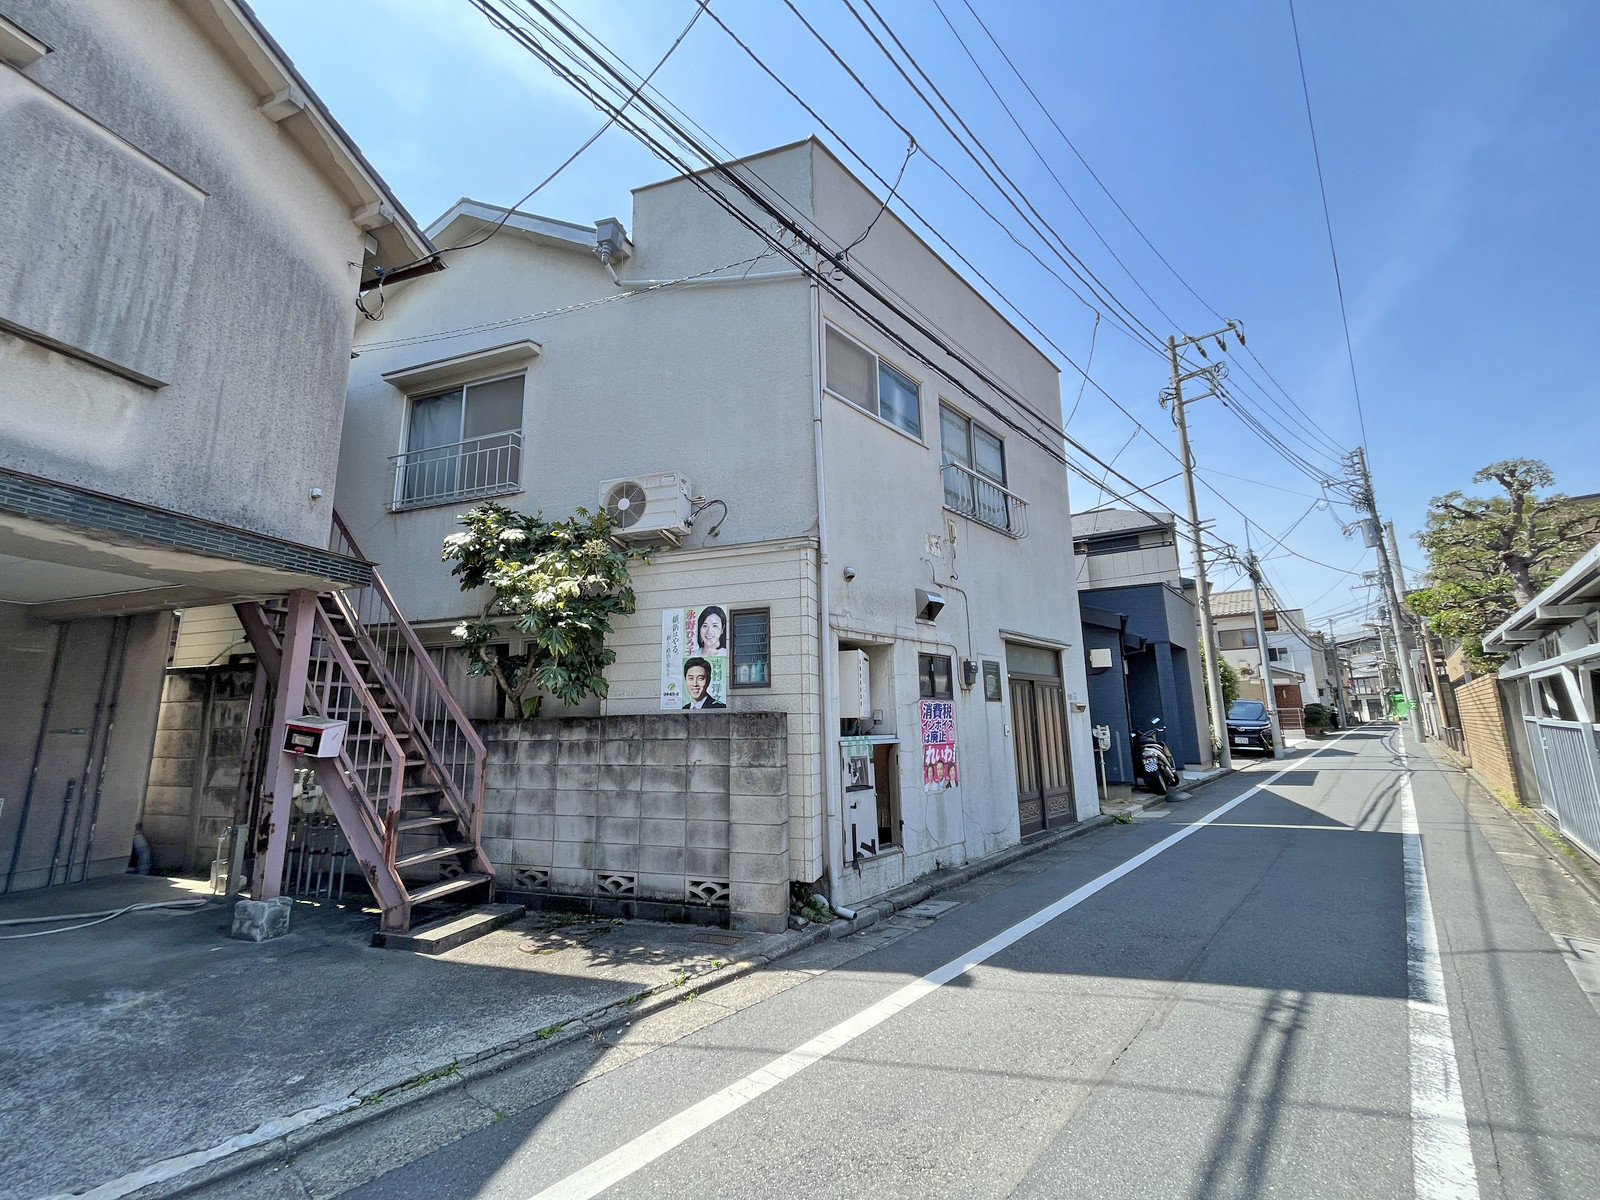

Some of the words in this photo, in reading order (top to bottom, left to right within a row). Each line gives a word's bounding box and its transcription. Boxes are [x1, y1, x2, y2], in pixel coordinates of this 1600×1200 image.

[711, 658, 722, 704] 吉村洋文
[922, 702, 952, 720] 消費税
[923, 730, 947, 744] は廃止
[925, 744, 956, 765] れいわ
